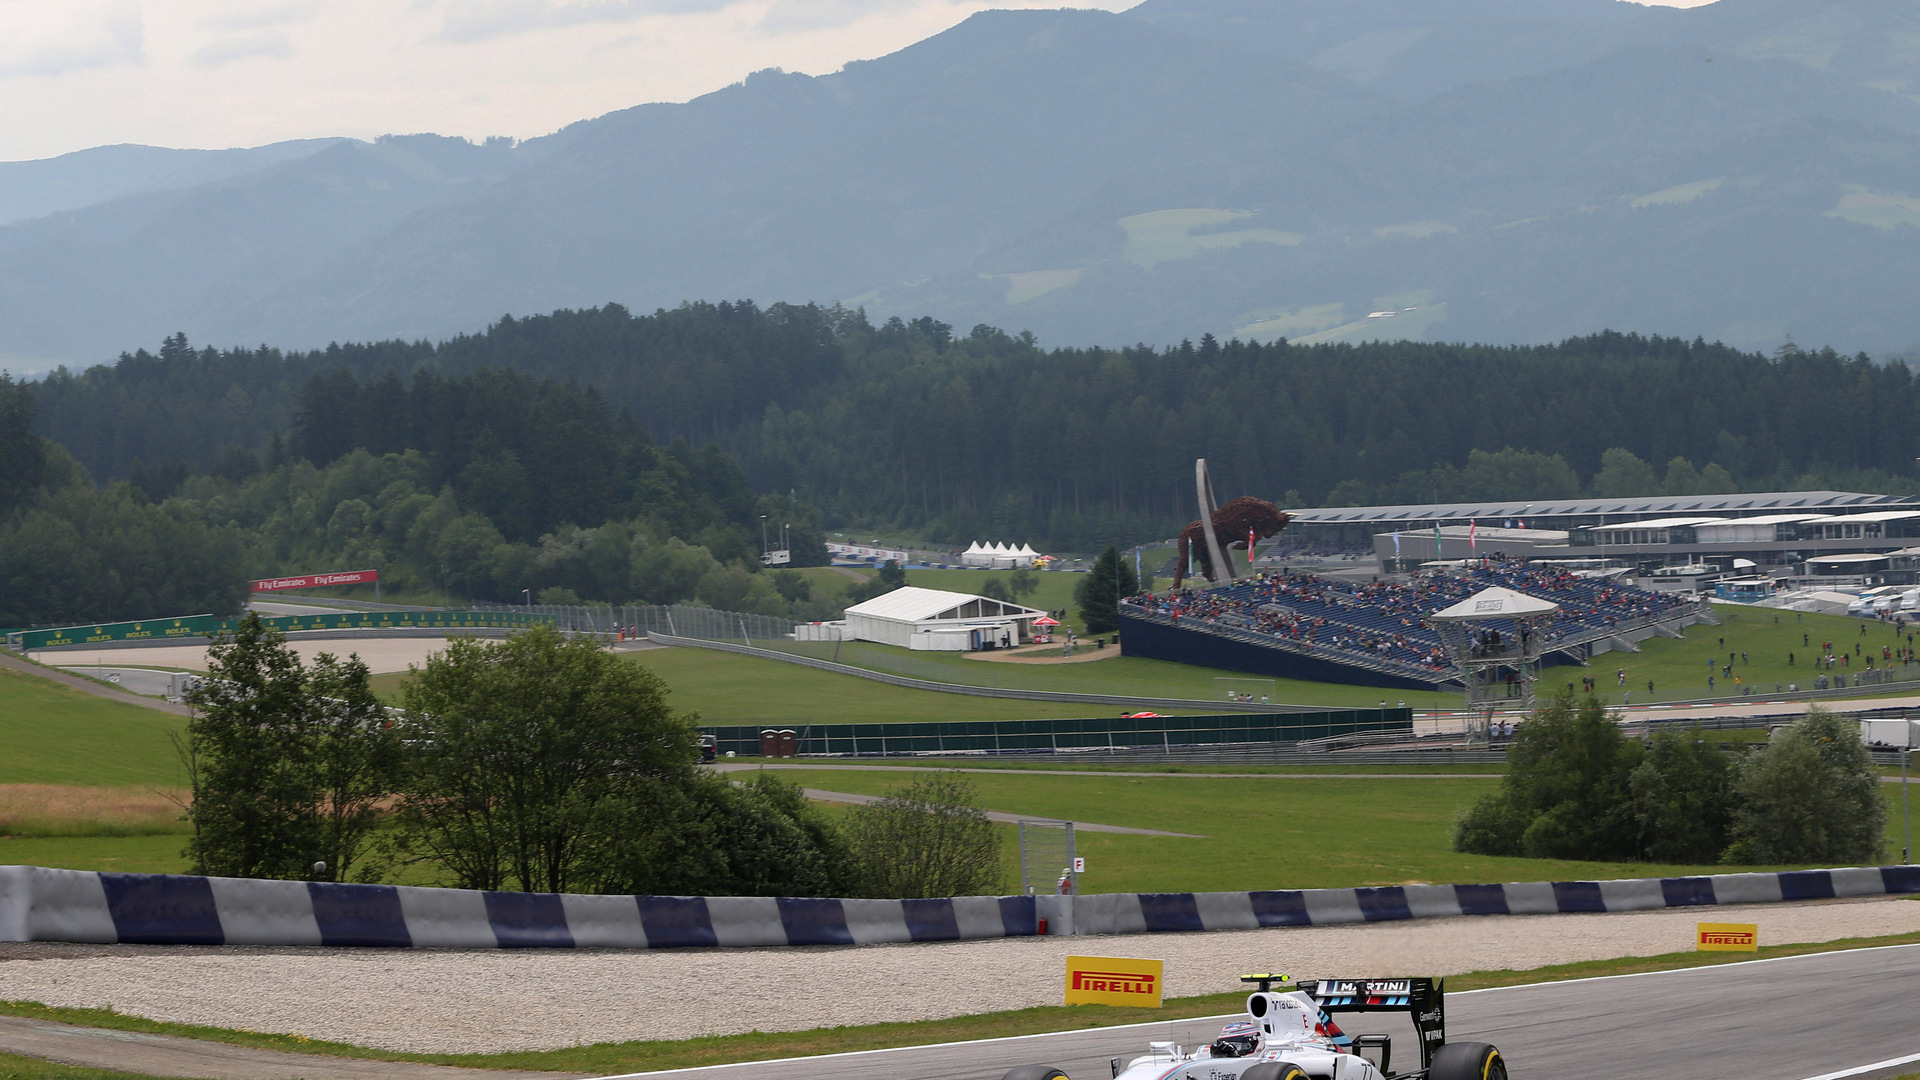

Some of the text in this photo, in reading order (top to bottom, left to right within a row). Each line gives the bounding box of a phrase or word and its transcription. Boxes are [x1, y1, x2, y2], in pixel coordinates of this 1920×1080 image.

[259, 579, 306, 589] Fly Emirates
[314, 574, 361, 585] Fly Emirates
[126, 631, 152, 639] ROLEX
[165, 627, 191, 635] ROLEX
[46, 638, 72, 646] ROLEX
[86, 634, 112, 642] ROLEX
[1076, 860, 1082, 869] F
[1701, 932, 1752, 944] PIRELLI
[1072, 971, 1155, 994] PIRELLI
[1302, 1014, 1308, 1028] E
